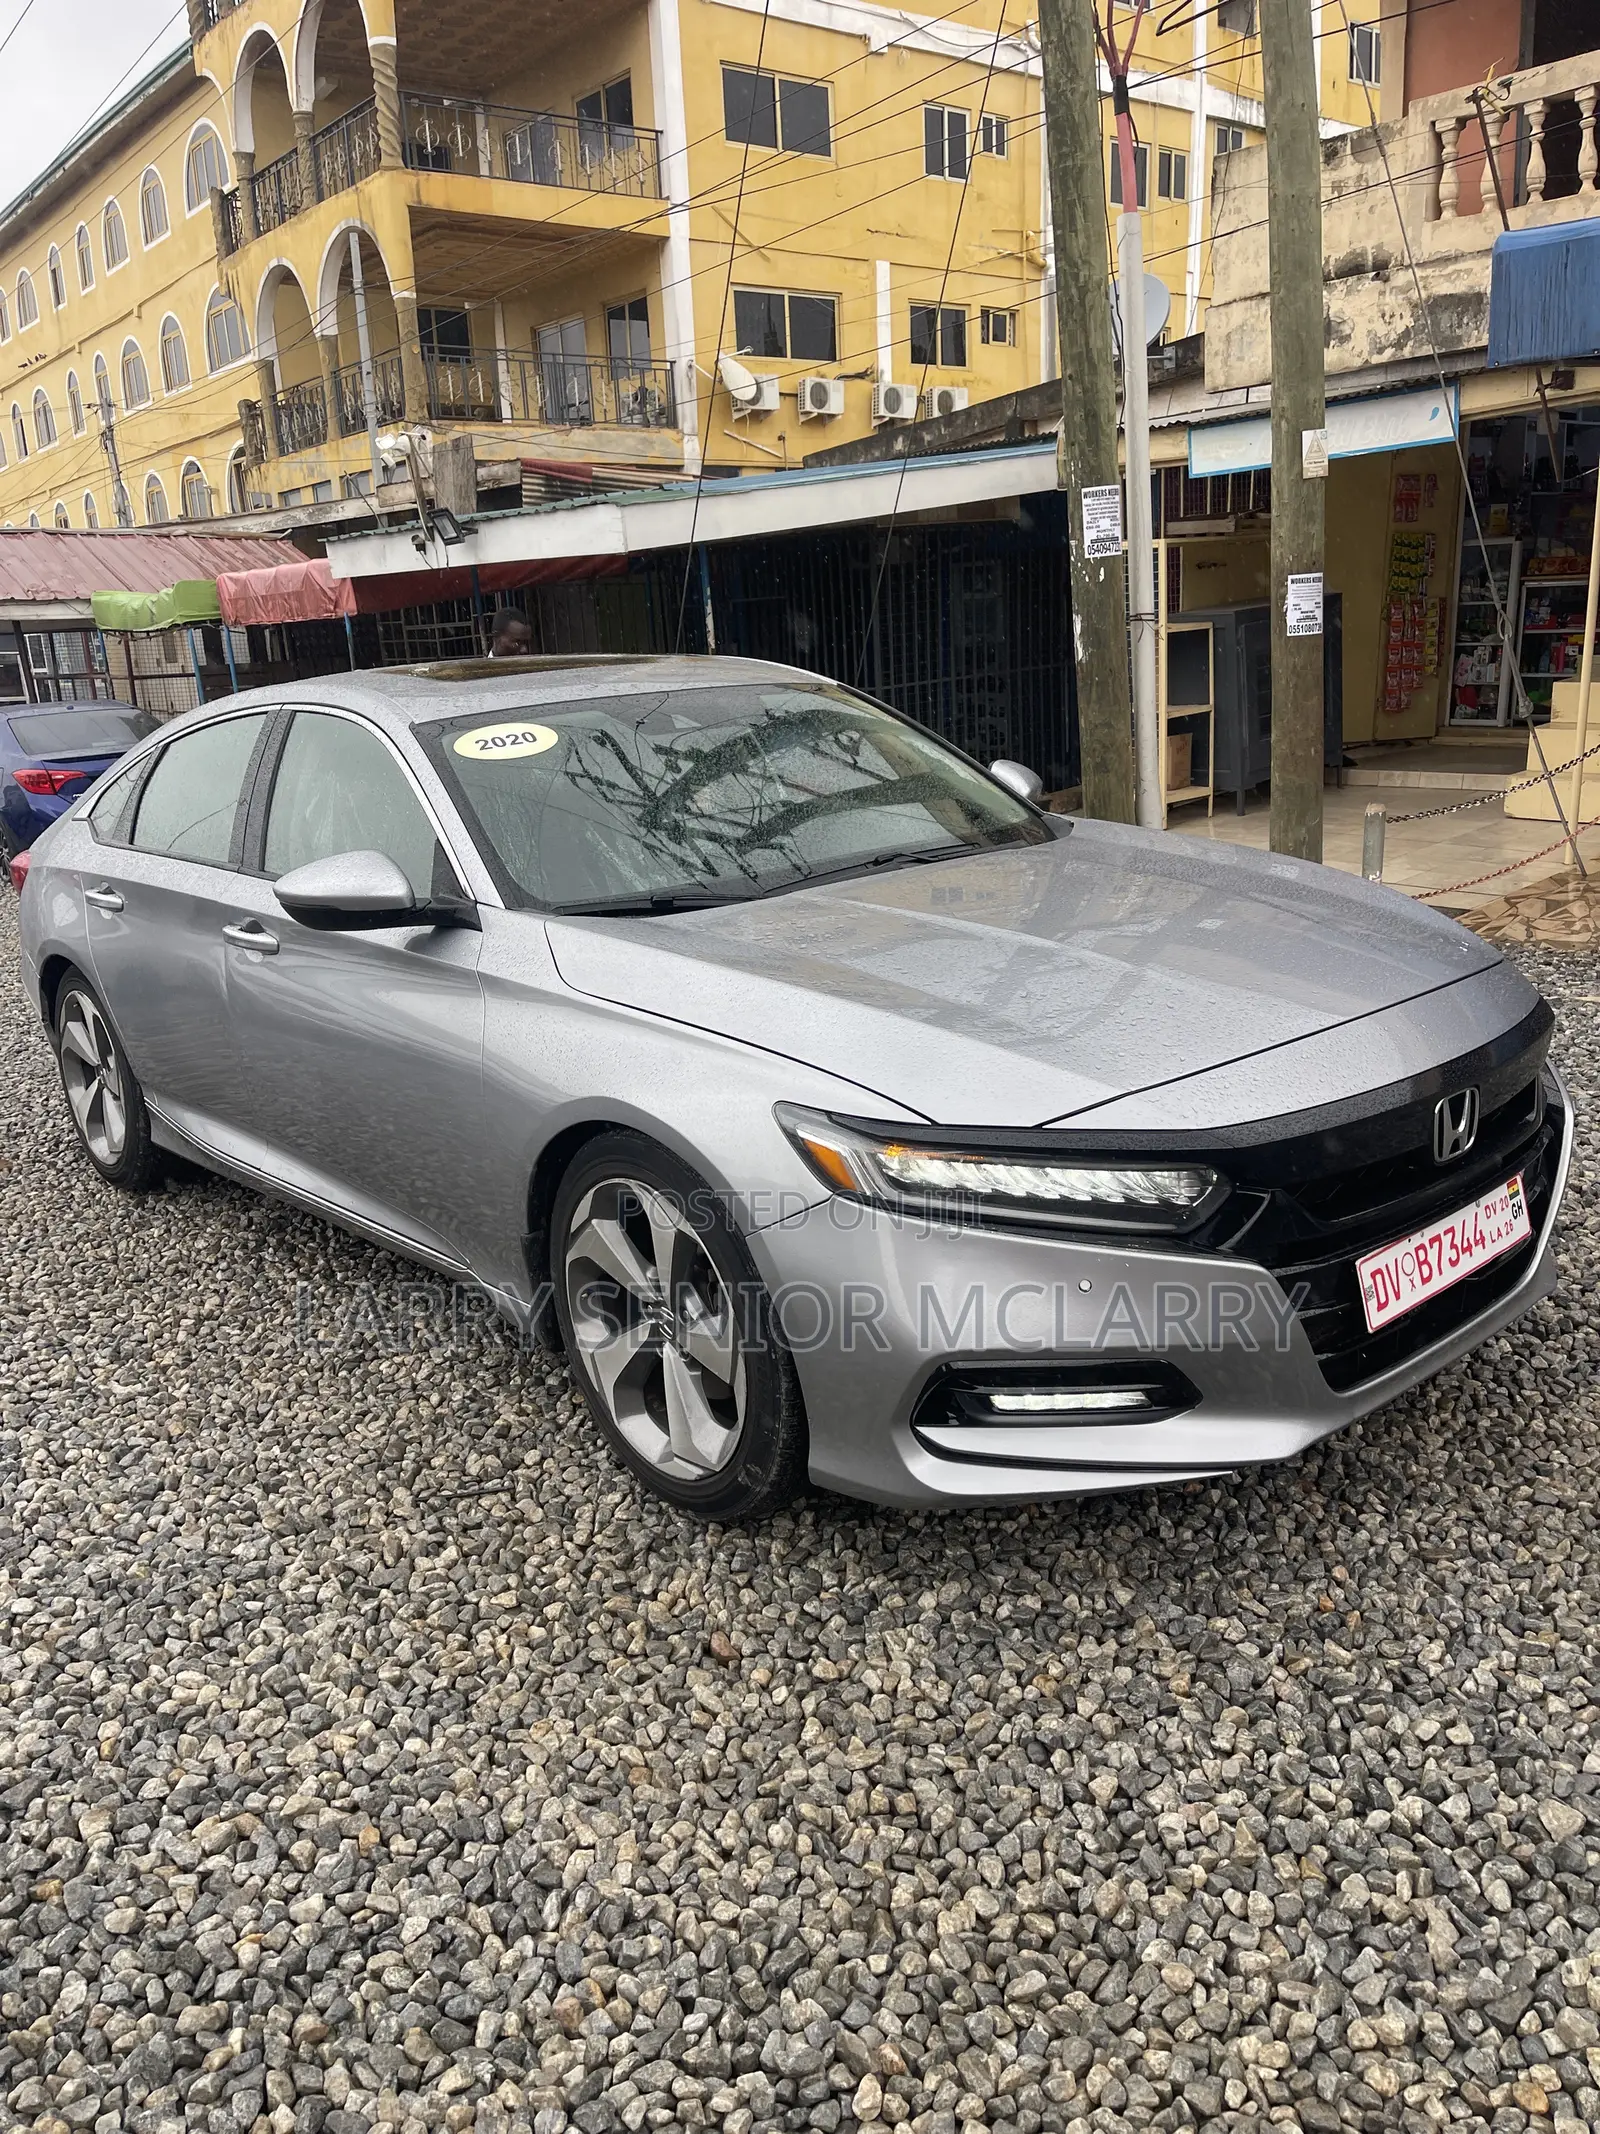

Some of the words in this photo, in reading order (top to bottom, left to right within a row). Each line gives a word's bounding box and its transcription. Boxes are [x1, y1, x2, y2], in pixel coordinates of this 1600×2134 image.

[1083, 489, 1107, 499] WORKERS
[475, 732, 537, 751] 2020
[1484, 1203, 1497, 1219] DV
[1499, 1195, 1510, 1211] 20
[1511, 1200, 1524, 1221] GH
[1490, 1227, 1502, 1244] LA
[1505, 1219, 1514, 1236] 26
[1370, 1258, 1400, 1312] DV
[1414, 1212, 1486, 1286] B7344
